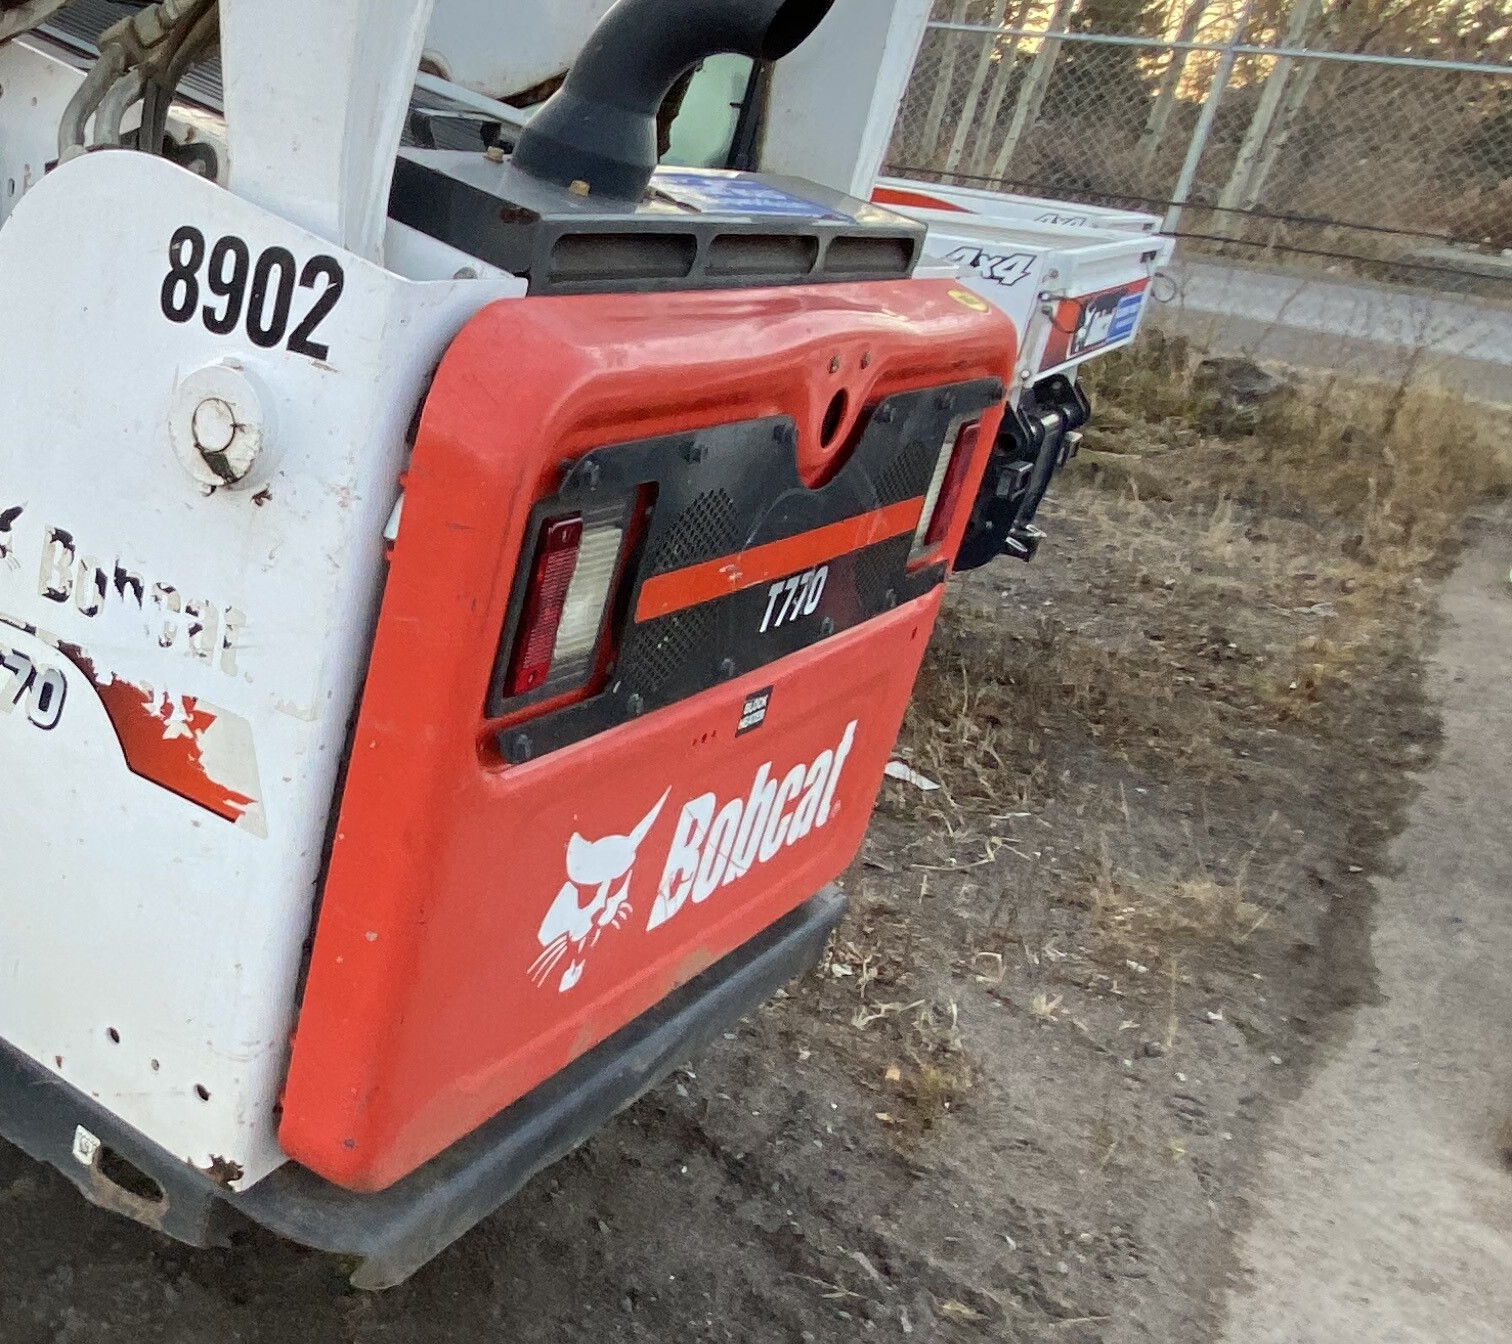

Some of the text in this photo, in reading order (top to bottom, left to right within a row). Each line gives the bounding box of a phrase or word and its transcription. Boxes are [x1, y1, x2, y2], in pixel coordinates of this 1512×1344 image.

[160, 225, 345, 361] 8902
[945, 246, 1037, 286] 4x4
[758, 565, 829, 633] T770
[645, 719, 859, 932] Bobcat
